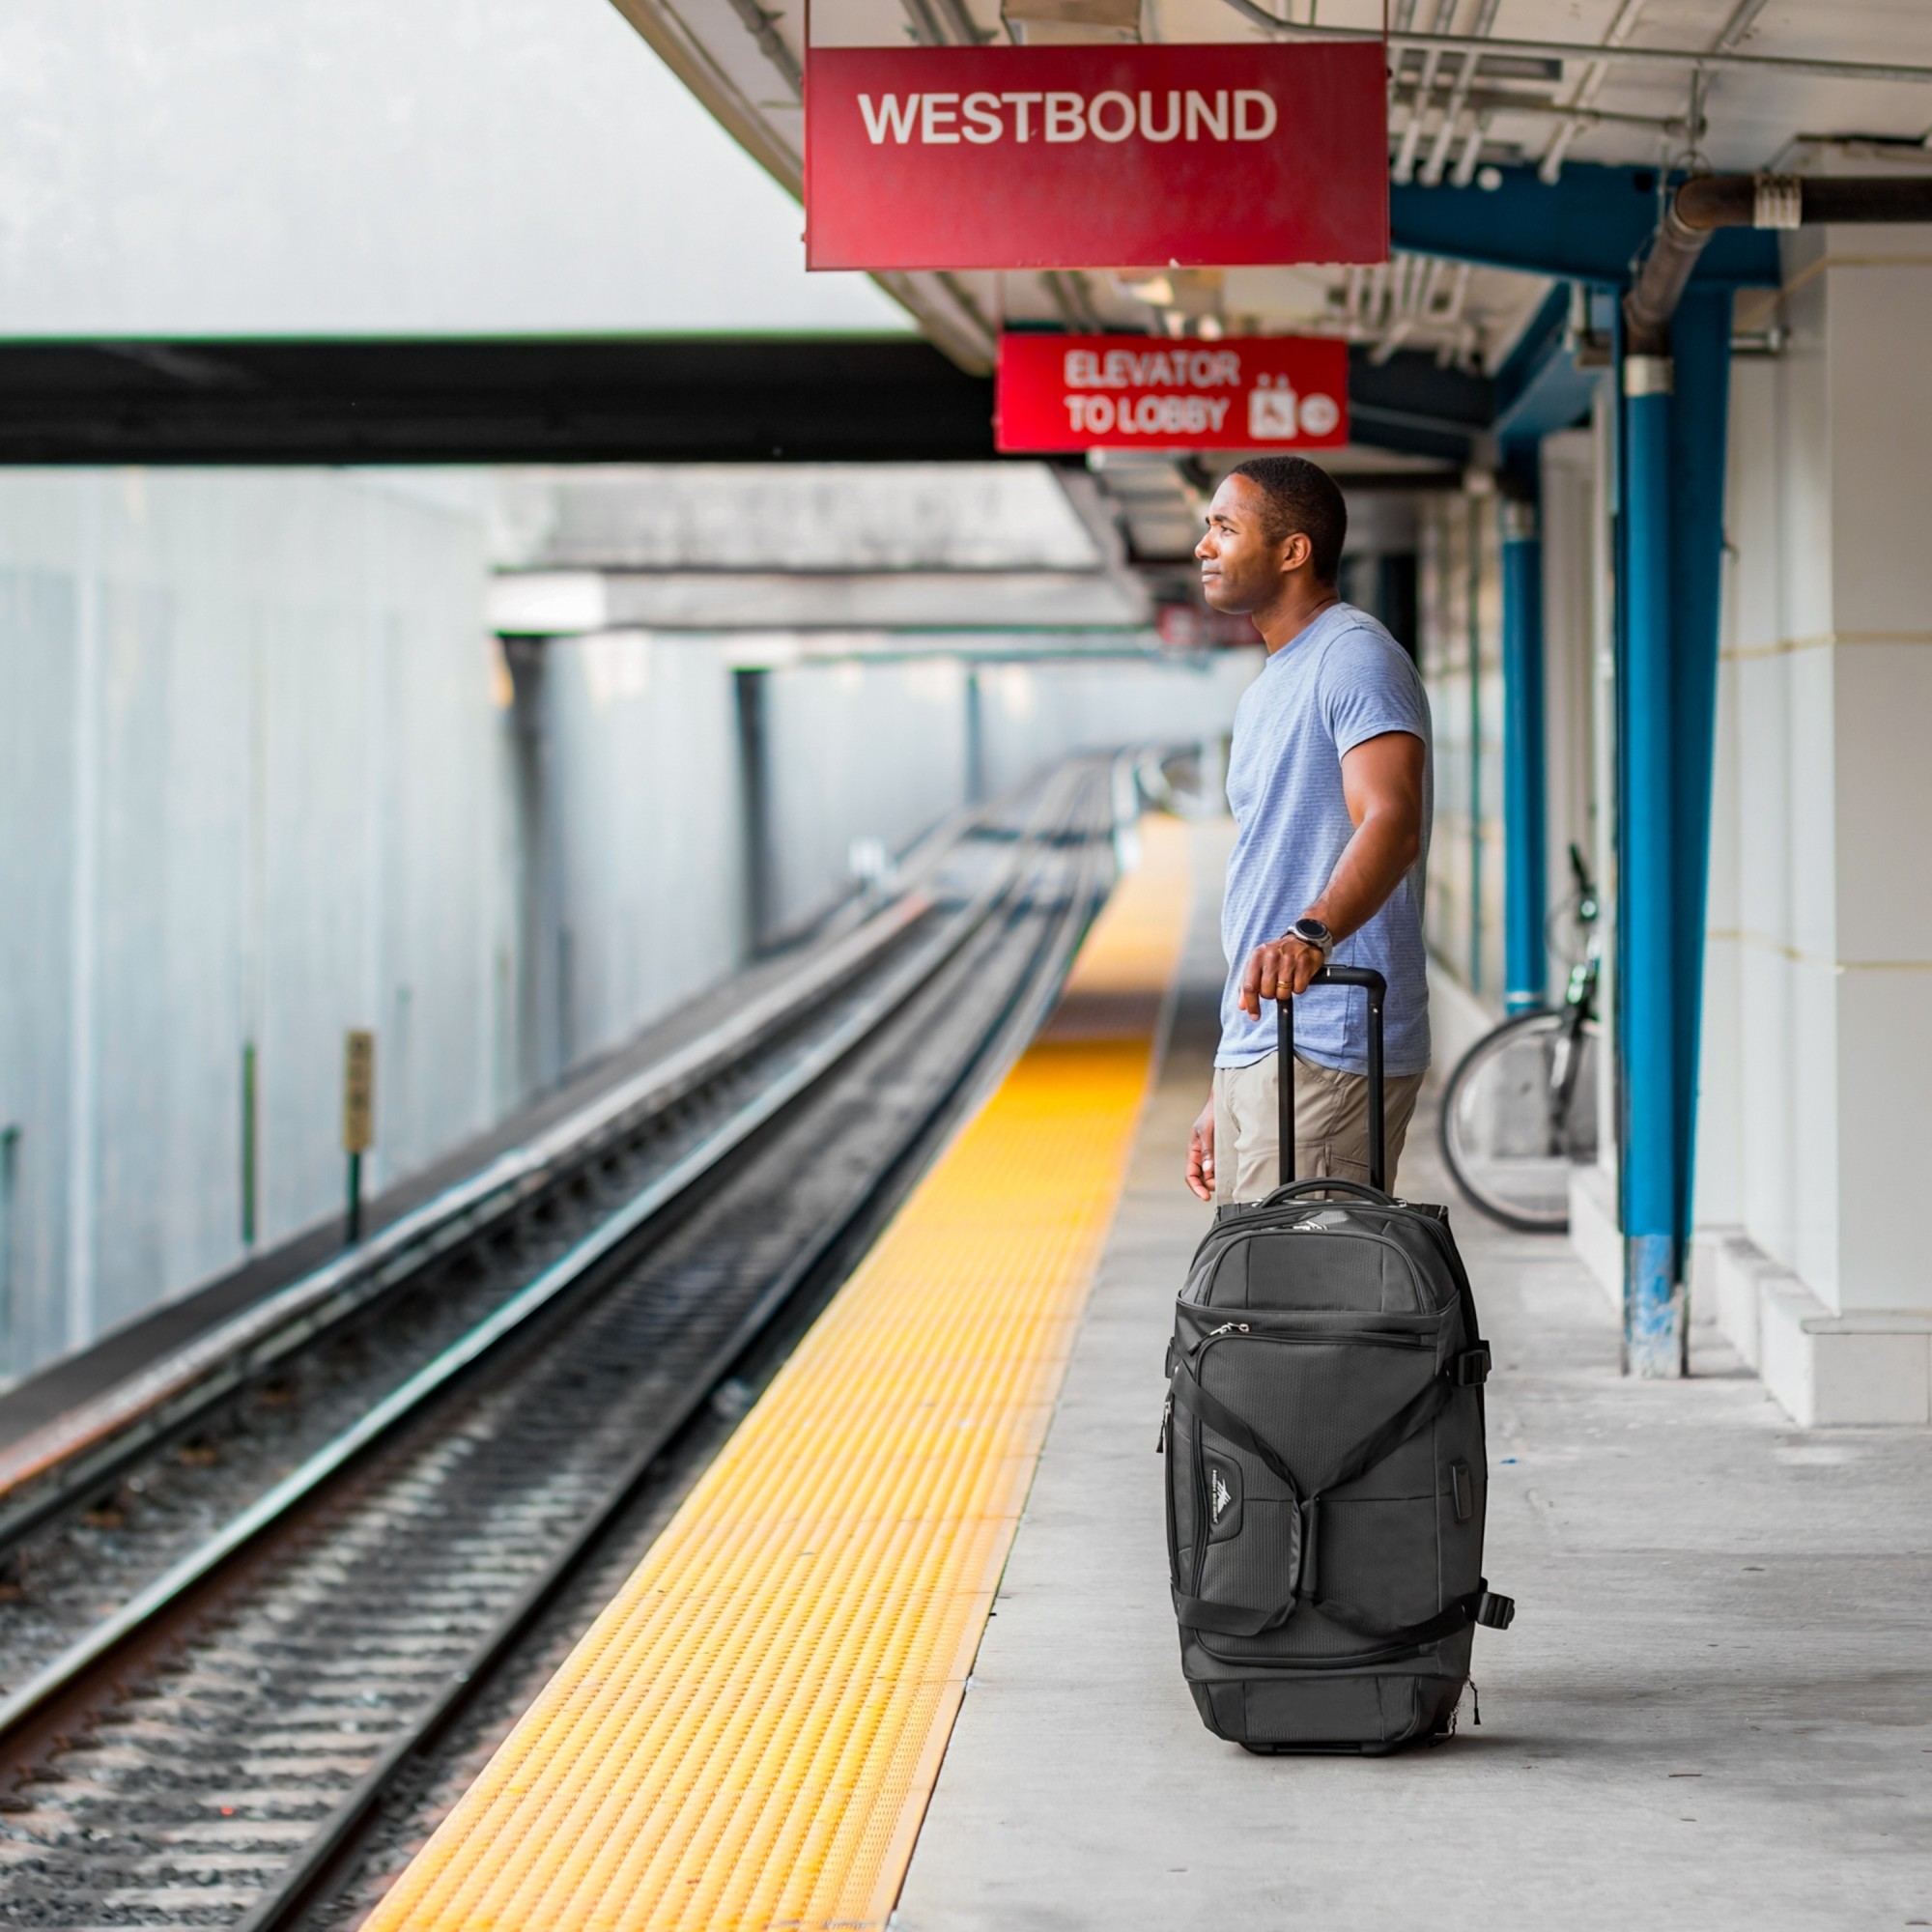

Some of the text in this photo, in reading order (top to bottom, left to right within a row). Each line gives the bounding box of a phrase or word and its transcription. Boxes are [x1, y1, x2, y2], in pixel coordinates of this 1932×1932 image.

[857, 90, 1277, 144] WESTBOUND
[1064, 349, 1241, 388] ELEVATOR
[1063, 394, 1231, 435] TO LOBBY
